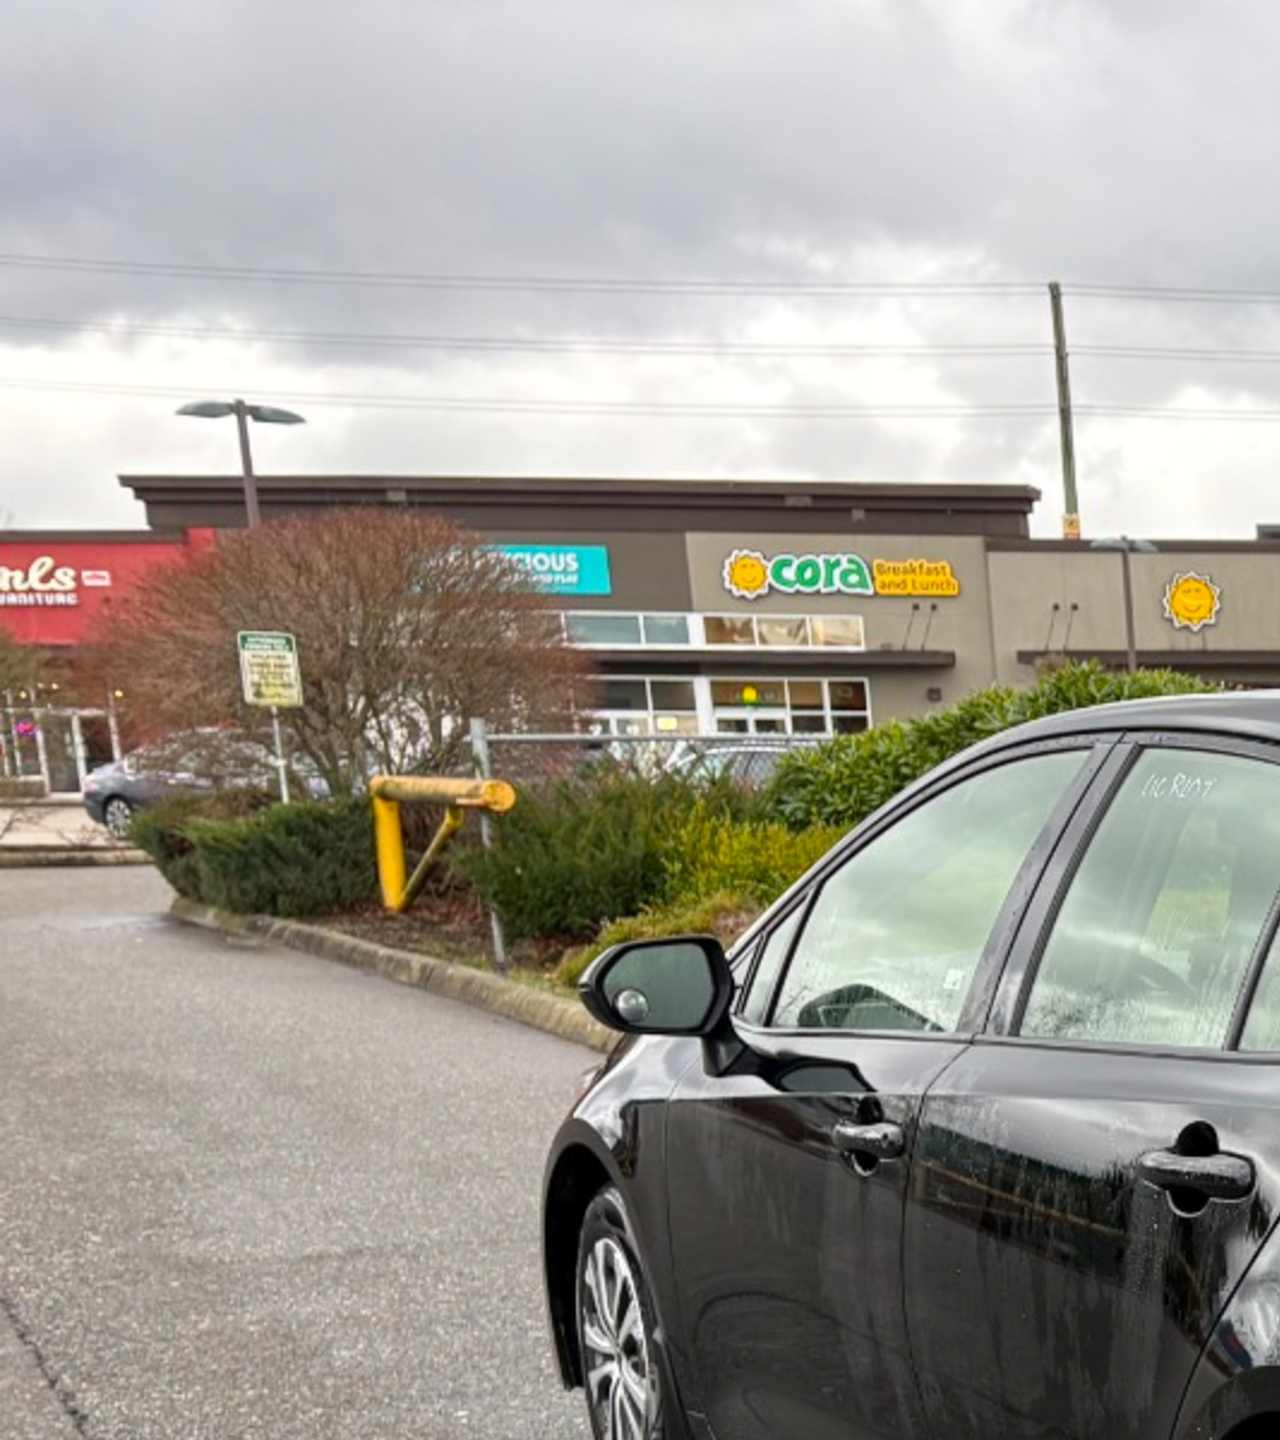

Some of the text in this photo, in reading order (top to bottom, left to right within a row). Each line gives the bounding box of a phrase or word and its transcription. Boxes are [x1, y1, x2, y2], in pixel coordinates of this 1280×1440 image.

[769, 556, 872, 594] cora
[876, 562, 948, 577] Breakfast
[878, 579, 957, 592] and Lunch
